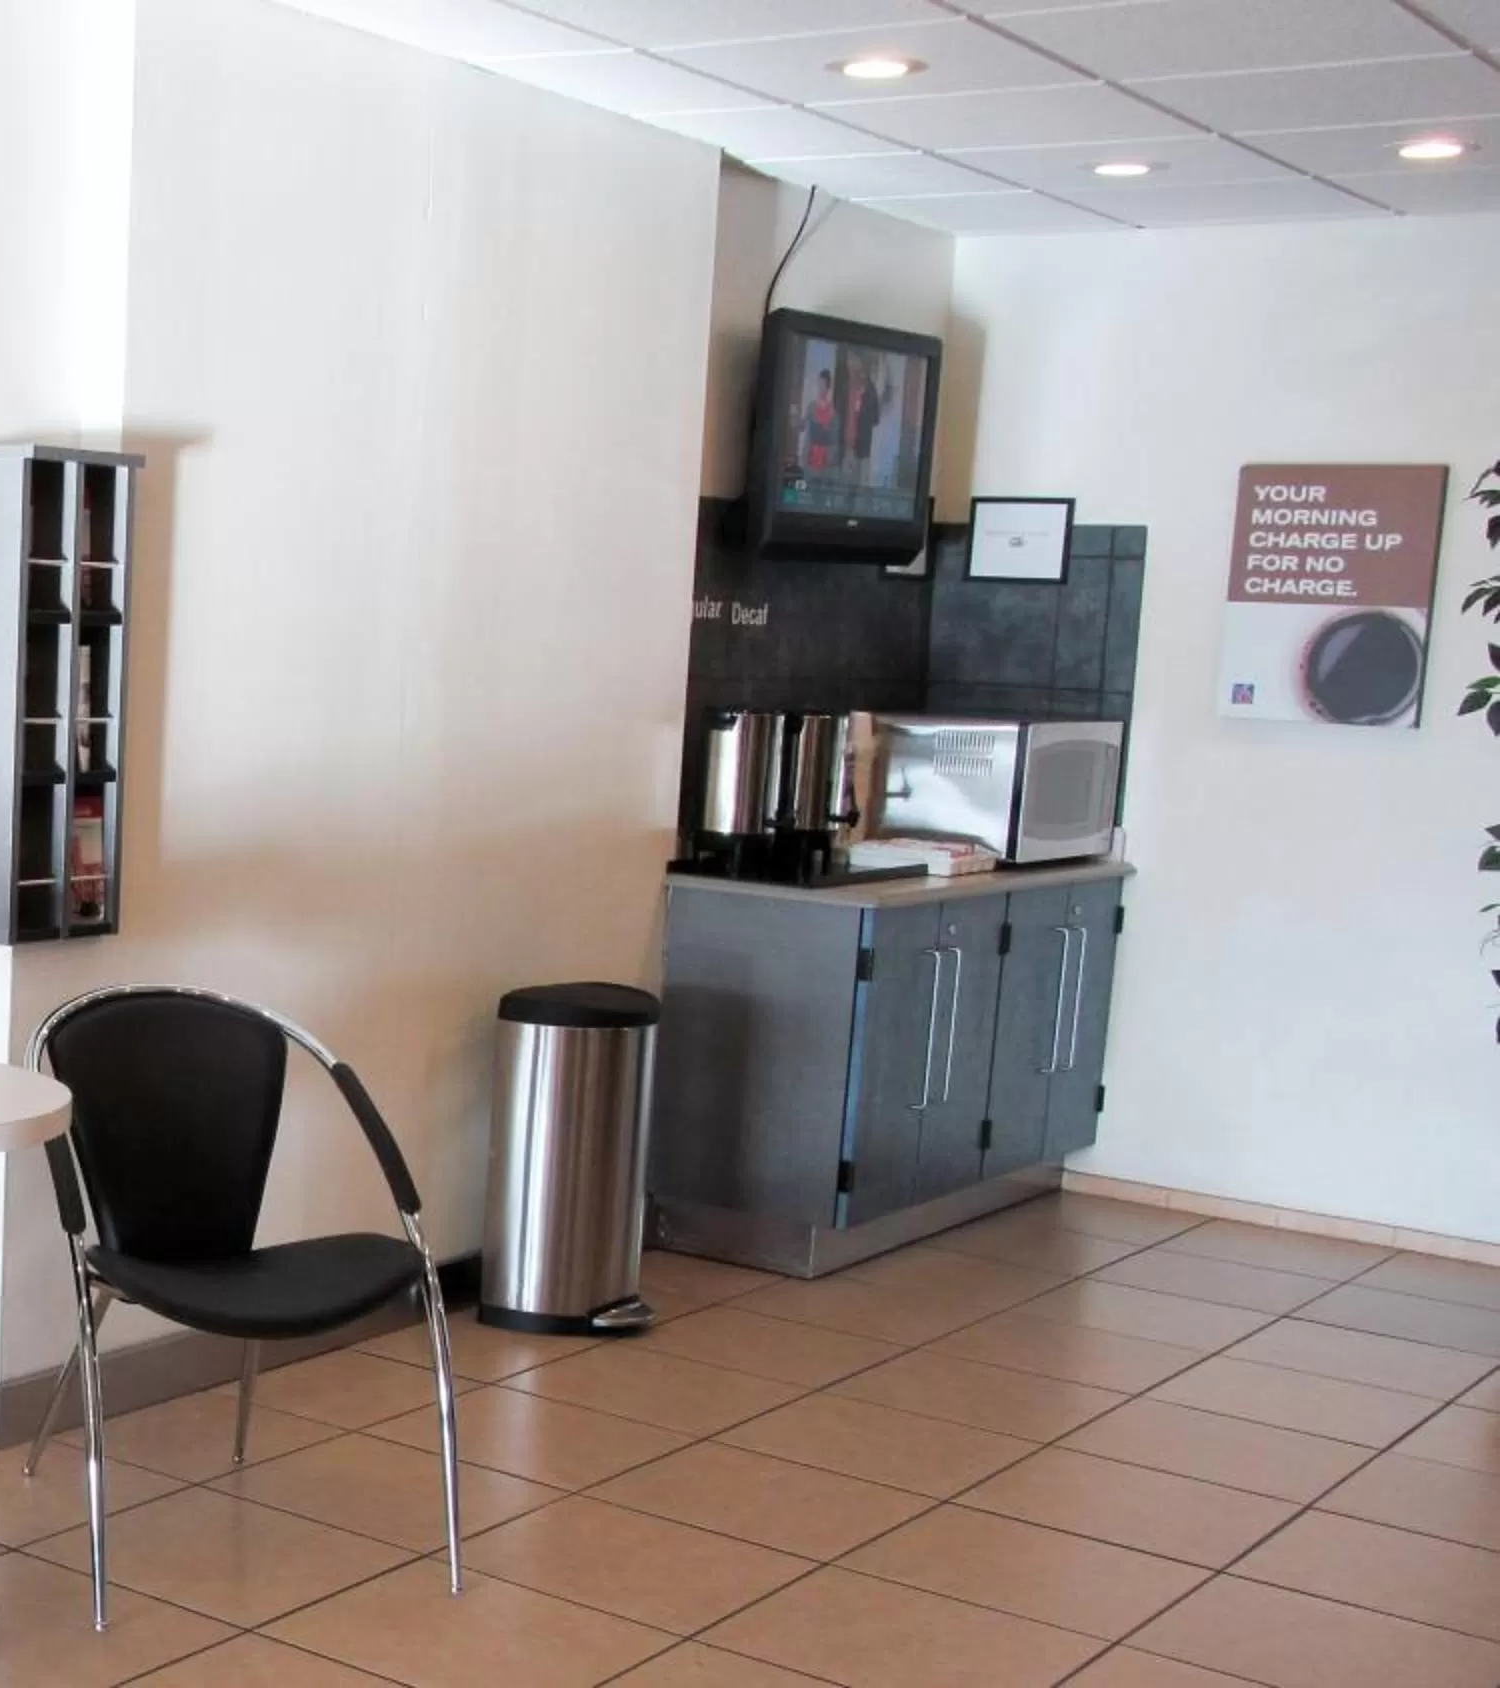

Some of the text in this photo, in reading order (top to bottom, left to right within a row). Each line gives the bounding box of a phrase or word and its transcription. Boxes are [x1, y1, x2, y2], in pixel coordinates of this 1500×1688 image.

[1254, 485, 1326, 503] YOUR
[1251, 508, 1377, 527] MORNING
[1249, 531, 1402, 551] CHARGE UP
[1247, 554, 1344, 573] FOR NO
[1244, 577, 1357, 597] CHARGE.
[731, 601, 769, 625] Decaf
